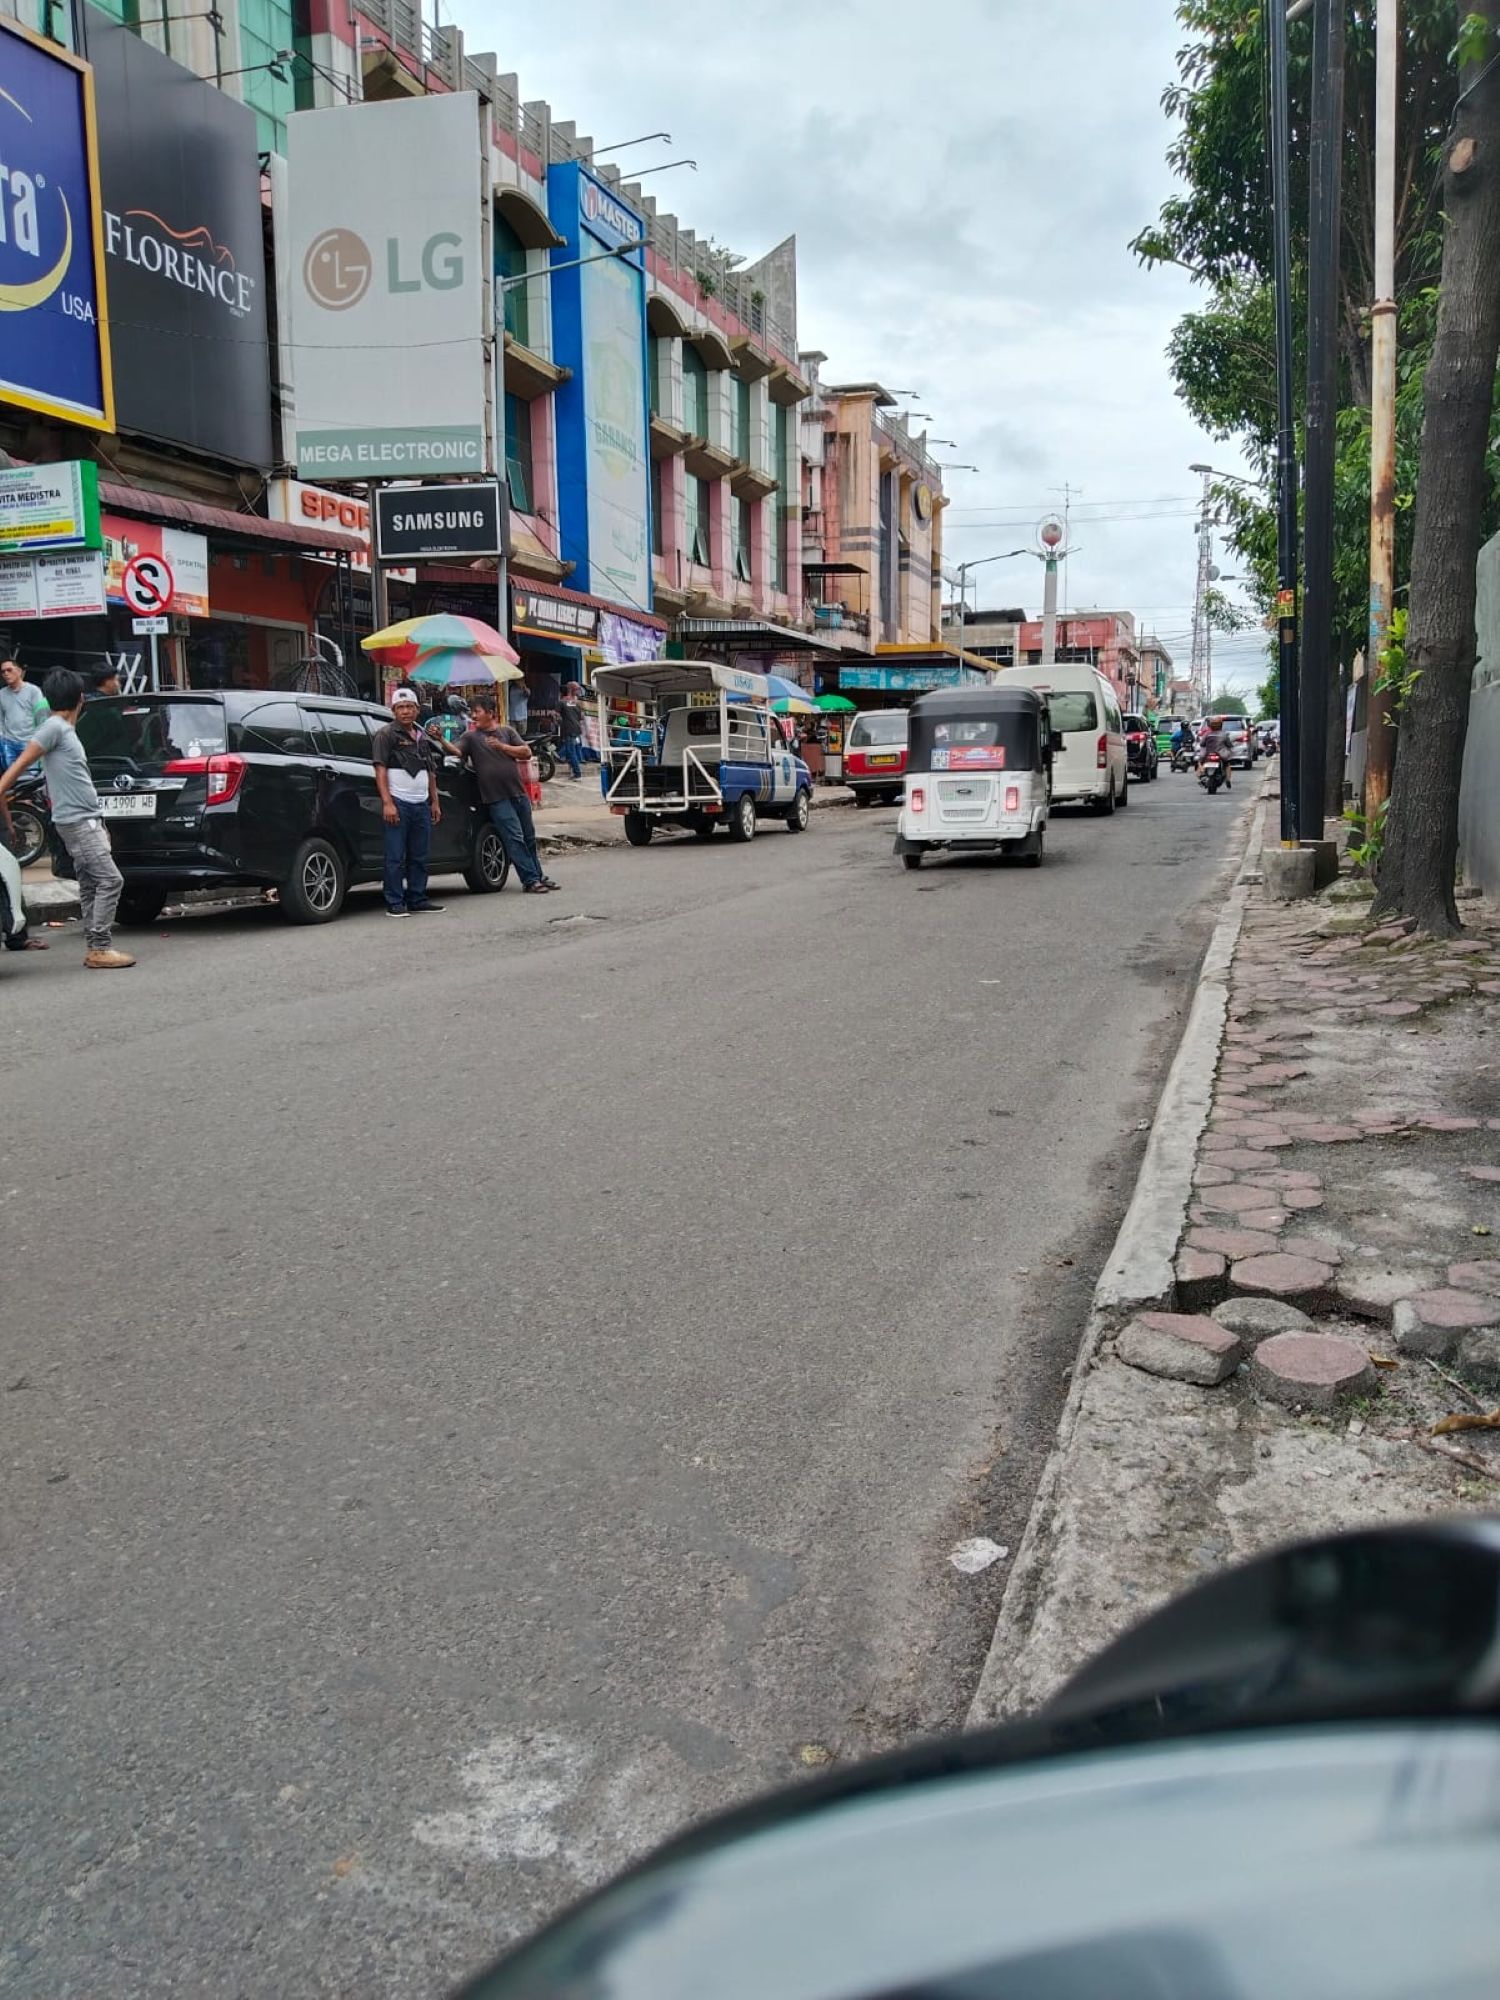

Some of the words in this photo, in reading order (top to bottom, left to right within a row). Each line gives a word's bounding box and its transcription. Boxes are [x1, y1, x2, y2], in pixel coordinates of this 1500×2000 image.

[104, 210, 251, 312] FLORENCE
[386, 231, 464, 294] LG
[62, 291, 95, 325] USA
[300, 445, 353, 464] MEGA
[357, 440, 477, 462] ELECTRONIC
[18, 488, 61, 502] MEDISTRA
[392, 510, 484, 532] SAMSUNG
[135, 562, 159, 605] S
[113, 796, 136, 809] 1990
